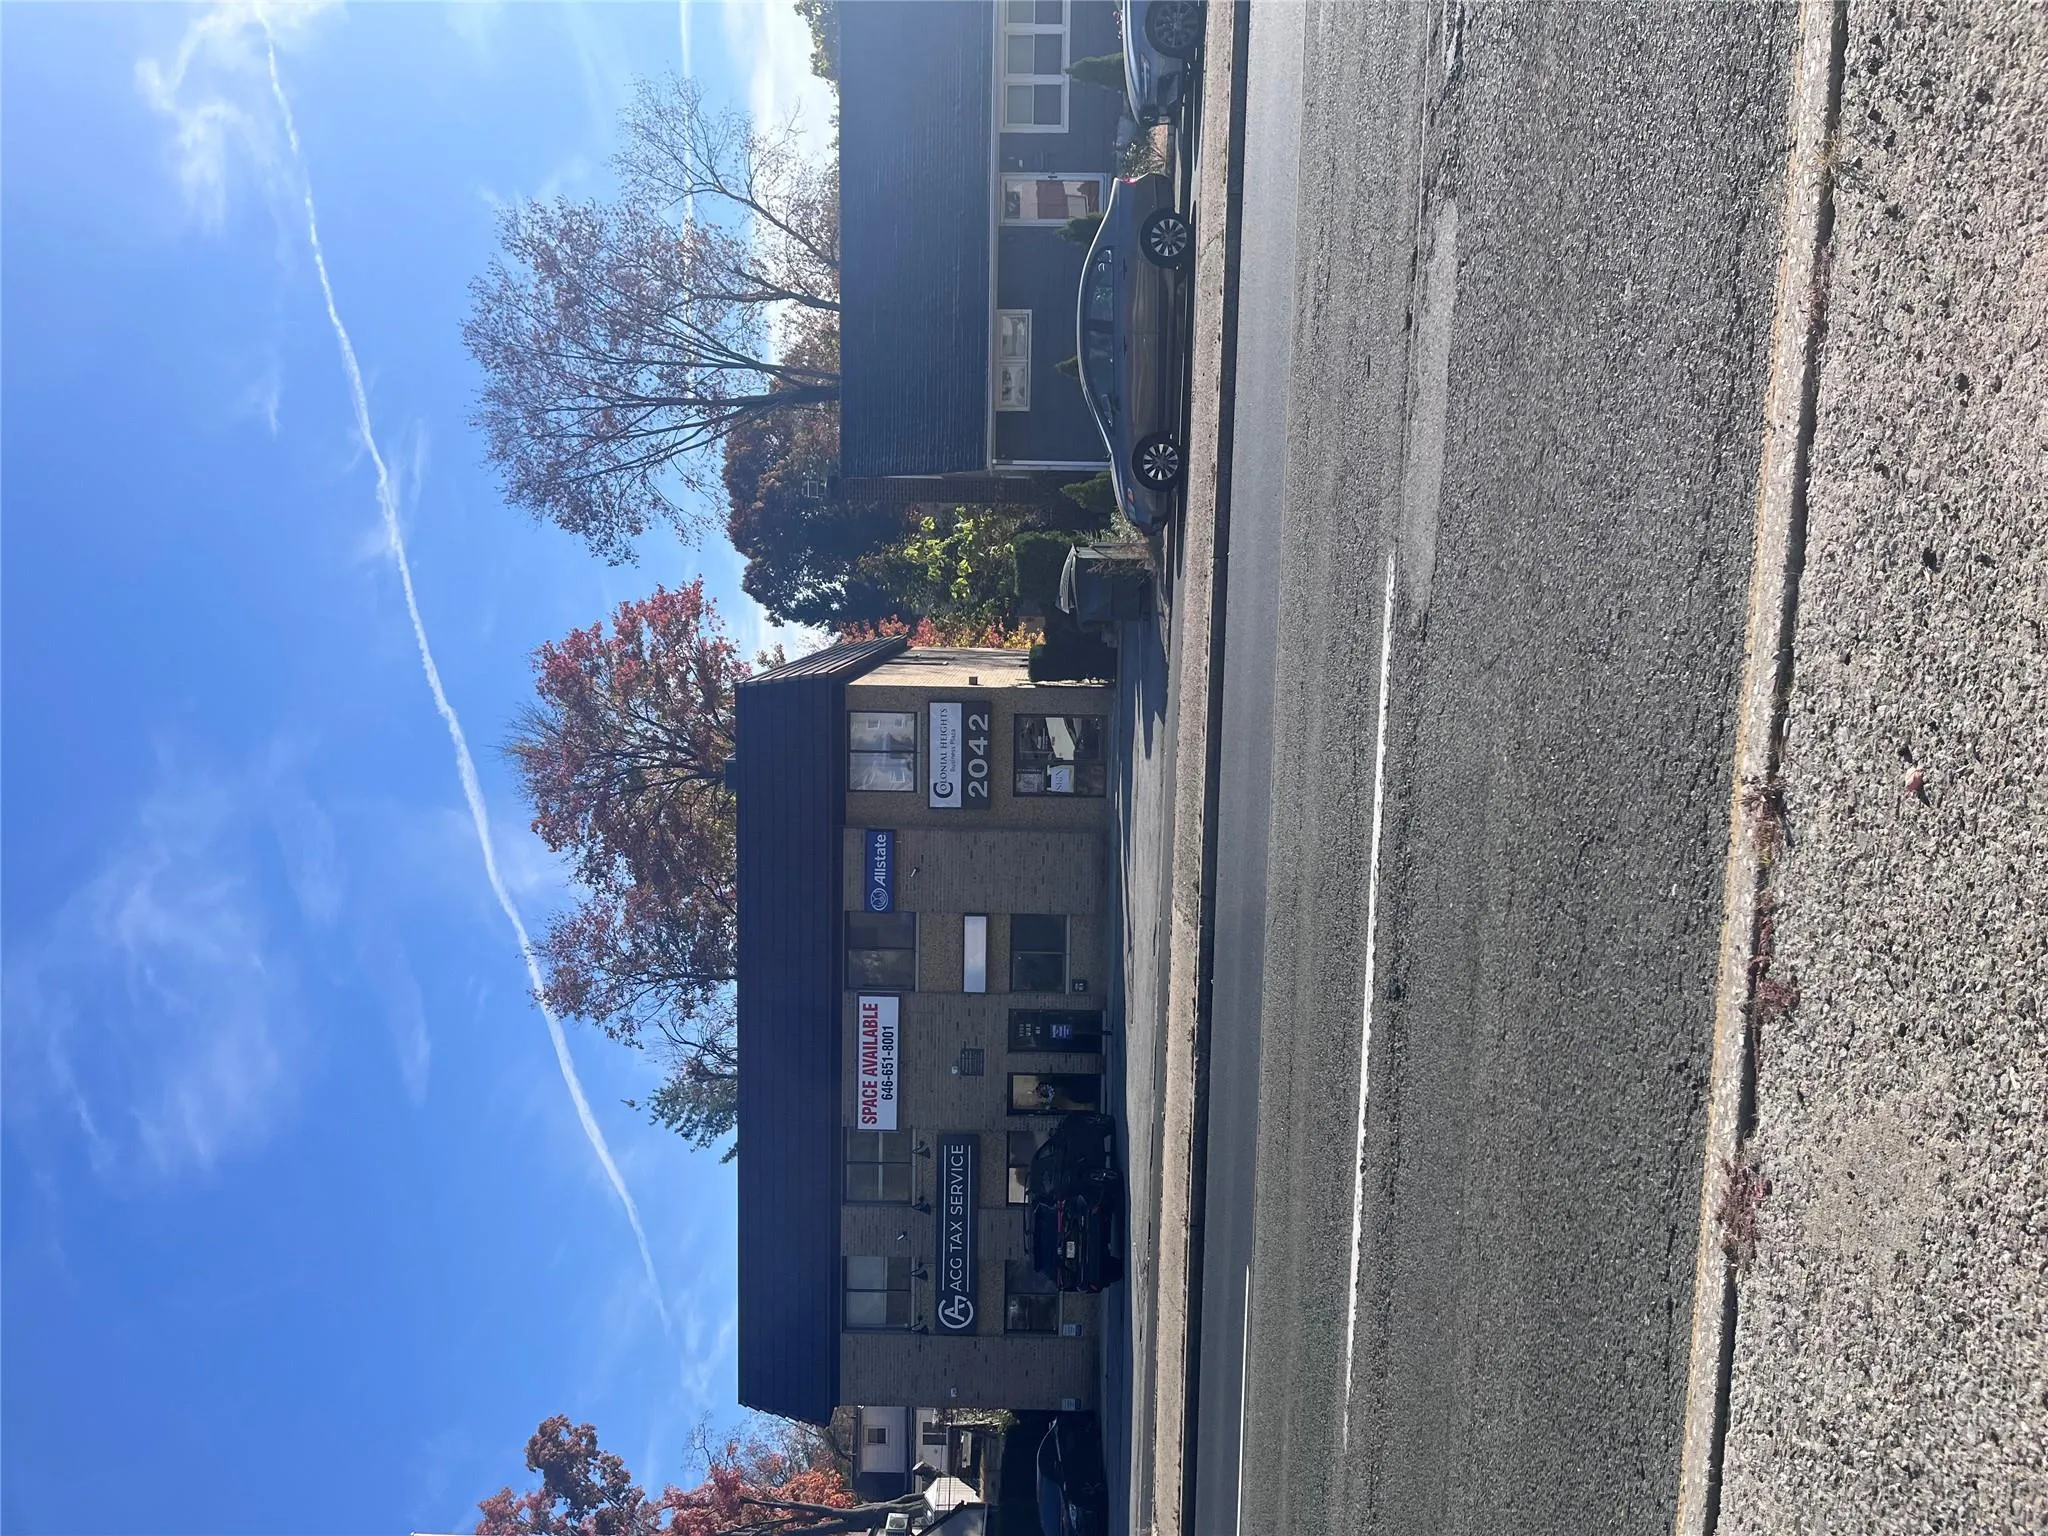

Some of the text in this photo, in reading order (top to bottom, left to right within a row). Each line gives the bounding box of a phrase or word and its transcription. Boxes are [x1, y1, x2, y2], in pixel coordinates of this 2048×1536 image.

[933, 708, 954, 798] COLONIAL HEIGHTS
[968, 714, 988, 798] 2042
[874, 834, 886, 886] Allstate
[862, 1004, 878, 1124] SPACE AVAILABLE
[881, 1026, 894, 1100] 646-651-8001
[949, 1144, 964, 1292] ACG TAX SERVICE
